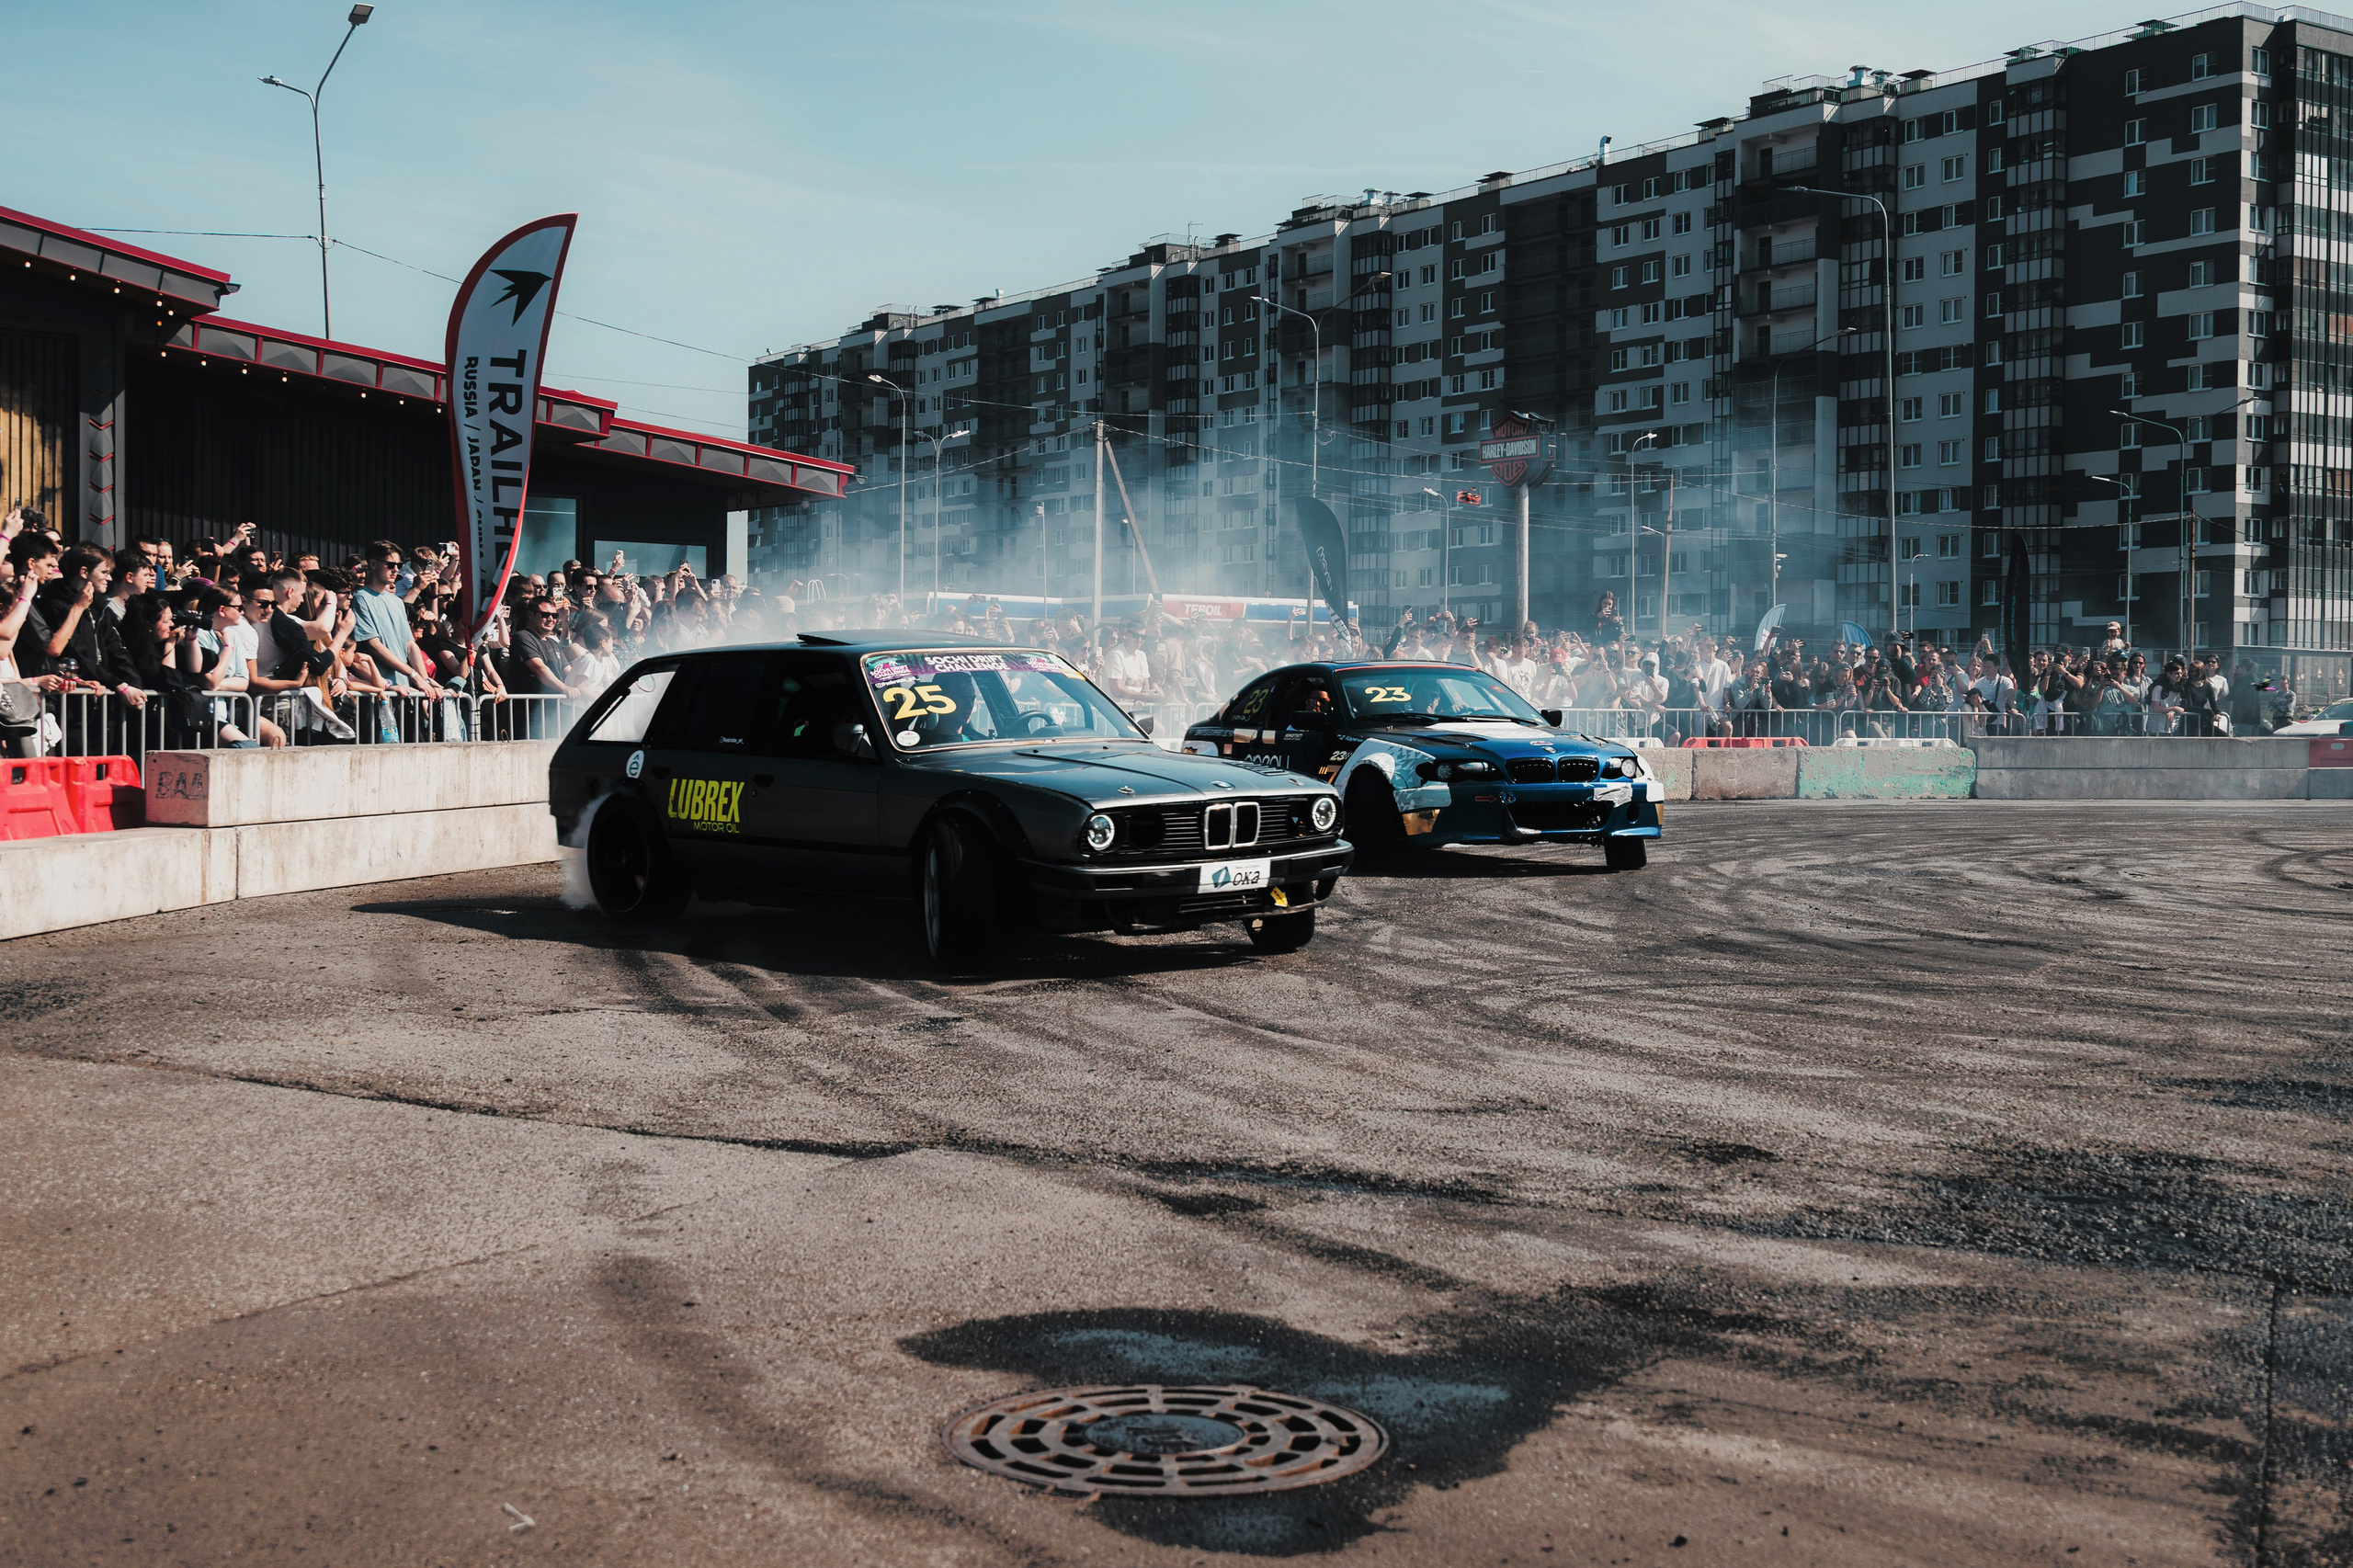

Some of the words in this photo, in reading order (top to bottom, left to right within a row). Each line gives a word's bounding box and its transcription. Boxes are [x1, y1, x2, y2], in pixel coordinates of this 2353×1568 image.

[463, 357, 479, 418] RUSSIA
[1495, 422, 1526, 437] MOTOR
[1482, 439, 1537, 460] HARLEY-DAVIDSON
[467, 436, 481, 490] JAPAN
[1494, 460, 1524, 481] CYCLES
[1185, 604, 1222, 616] TEBOIL
[925, 654, 969, 665] SOCHI
[967, 654, 1004, 664] DRIFT
[935, 662, 1010, 672] CHALLENGE
[882, 685, 957, 720] 25
[1244, 688, 1268, 714] 23
[1365, 687, 1412, 703] 23
[1330, 751, 1347, 761] 23
[667, 778, 745, 823] LUBREX
[693, 821, 724, 833] MOTOR
[725, 823, 740, 834] OIL
